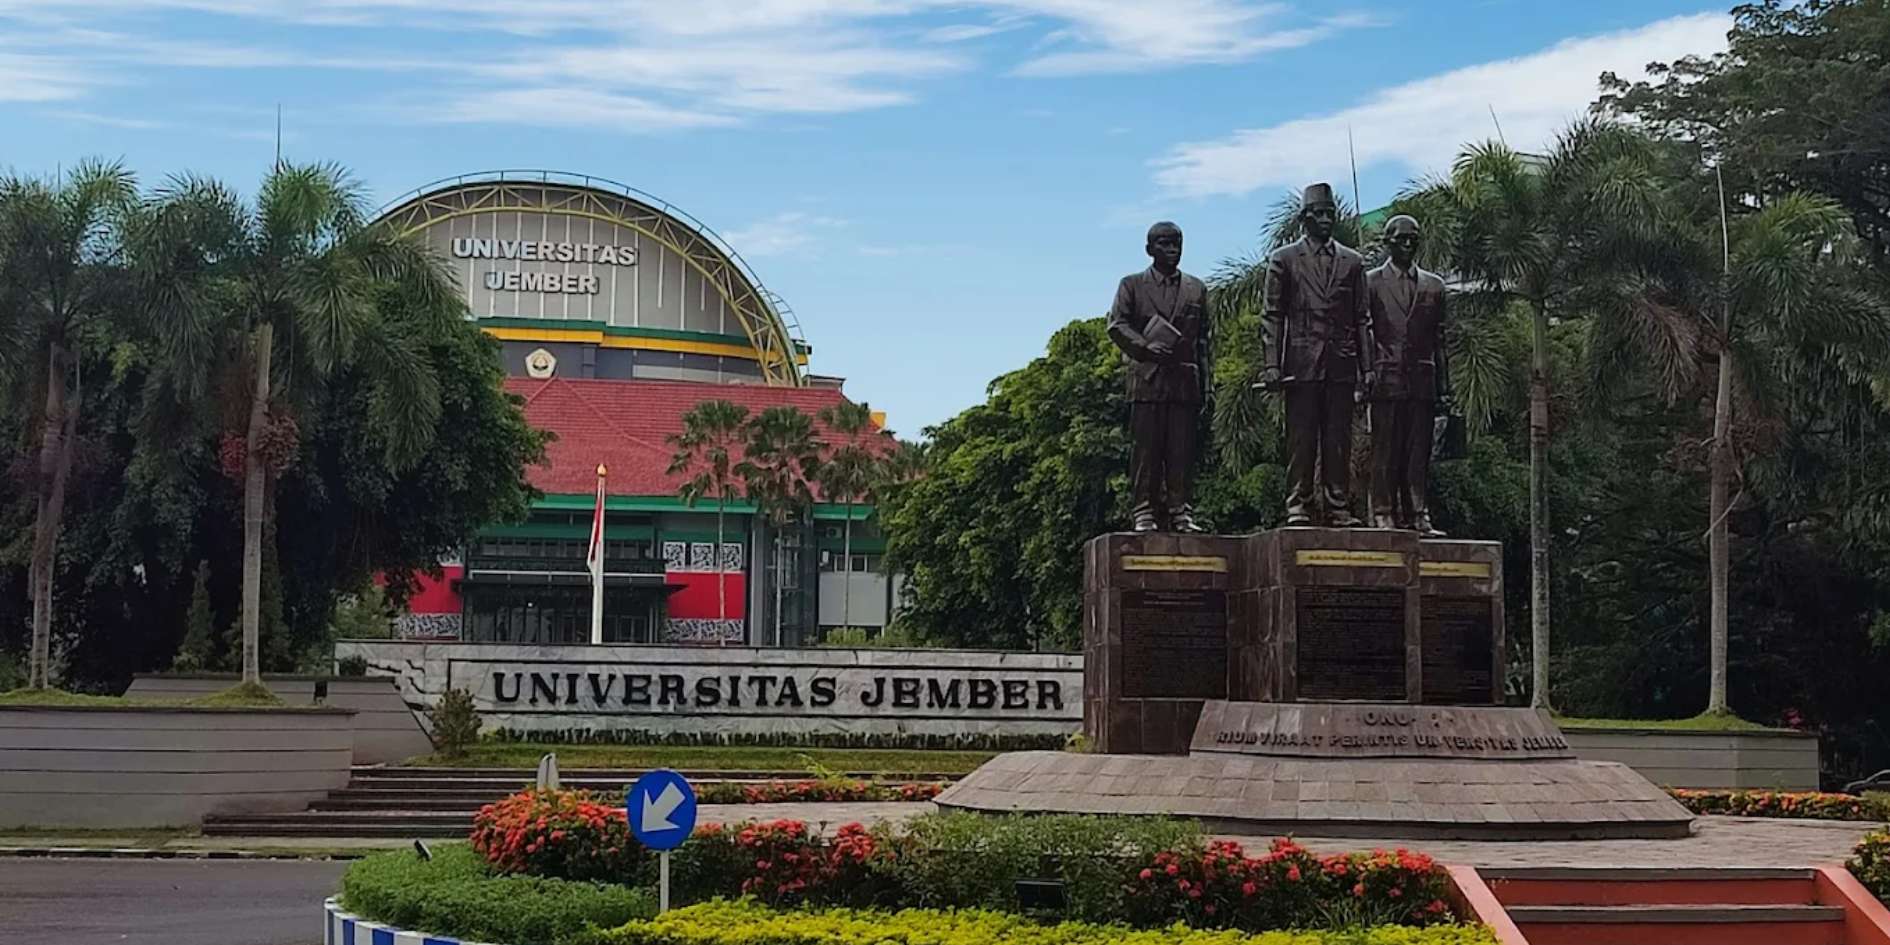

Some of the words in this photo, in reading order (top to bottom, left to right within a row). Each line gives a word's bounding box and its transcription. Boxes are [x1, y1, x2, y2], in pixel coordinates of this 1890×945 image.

[452, 237, 638, 265] UNIVERSITAS
[486, 271, 599, 294] JEMBER
[492, 672, 836, 708] UNIVERSITAS
[860, 676, 1064, 711] JEMBER
[1414, 734, 1519, 751] UNVERSITAS
